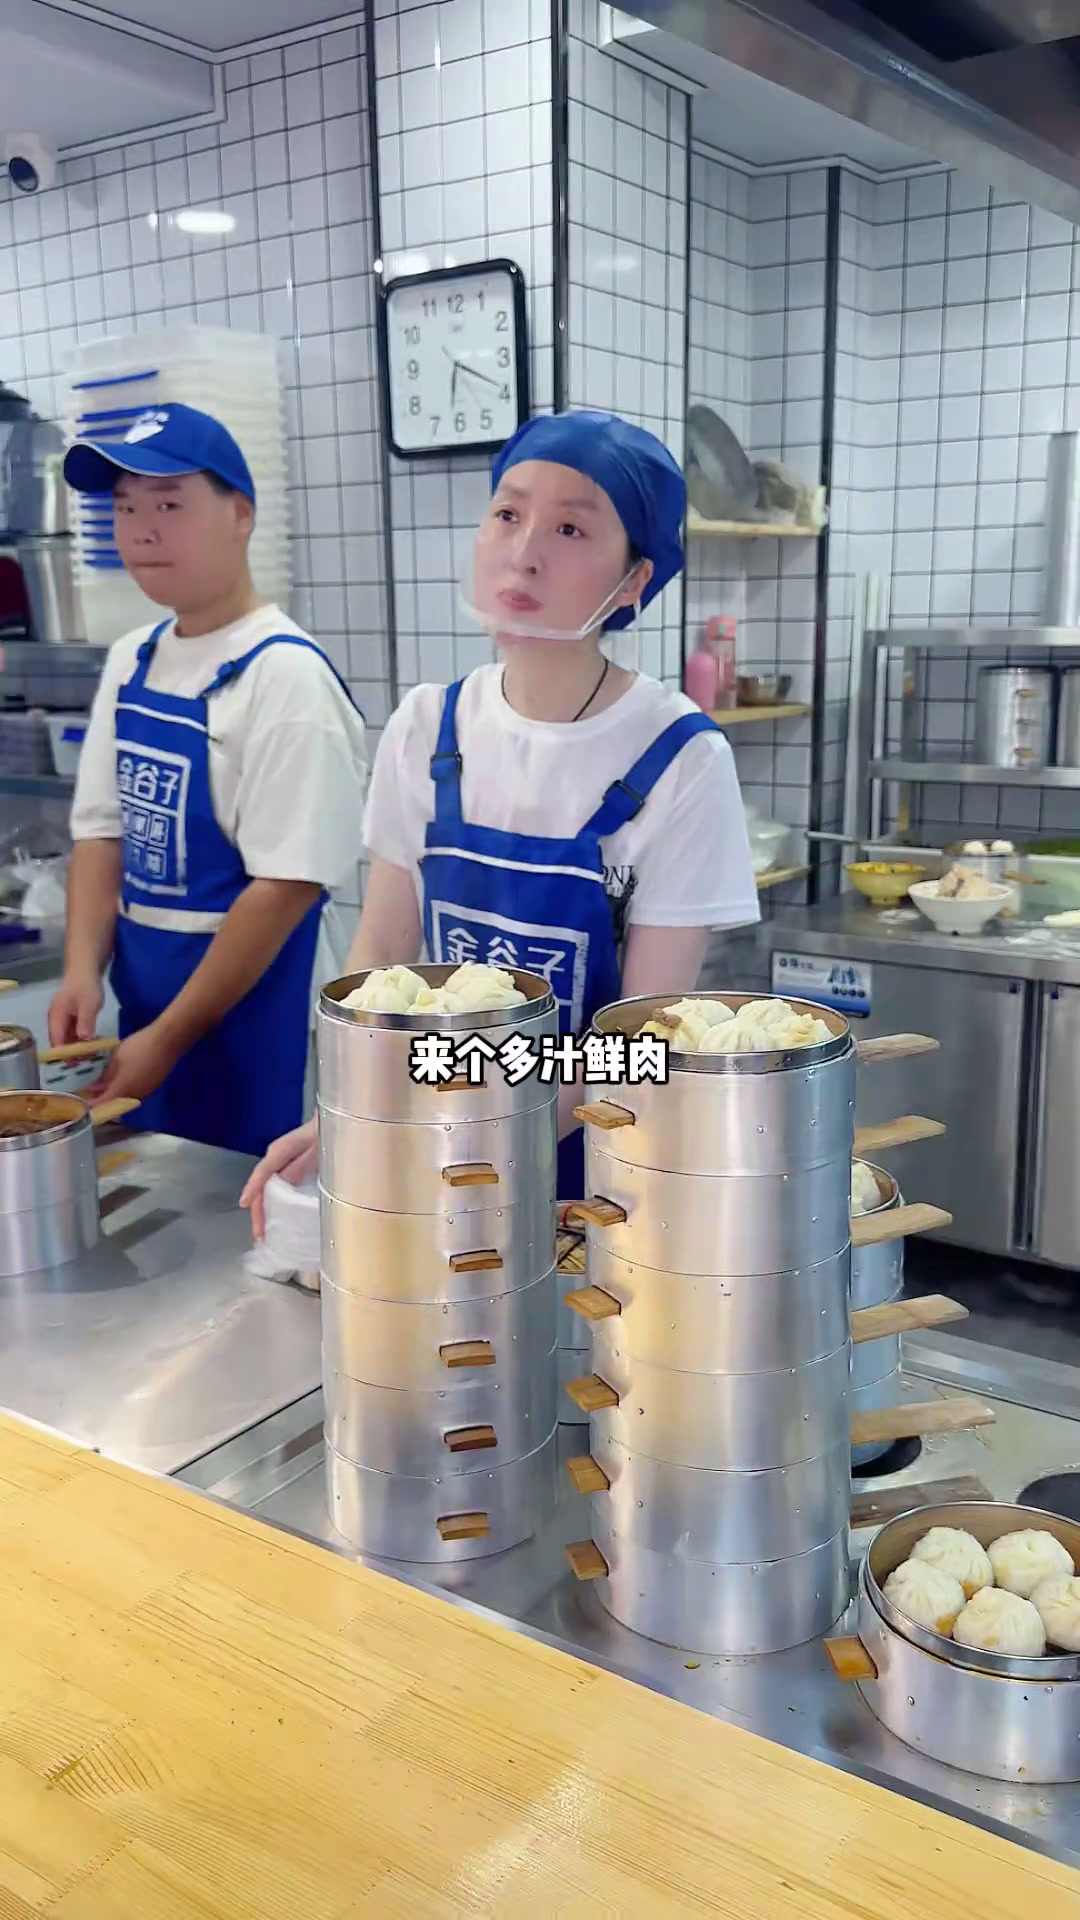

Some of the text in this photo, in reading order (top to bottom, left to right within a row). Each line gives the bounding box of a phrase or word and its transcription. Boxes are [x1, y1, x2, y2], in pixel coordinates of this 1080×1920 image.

[422, 300, 438, 318] 11
[448, 294, 464, 313] 12
[478, 291, 485, 311] 1
[495, 311, 509, 332] 2
[404, 325, 421, 345] 10
[498, 347, 511, 369] 3
[407, 359, 419, 380] 9
[500, 384, 511, 404] 4
[409, 396, 422, 416] 8
[430, 415, 441, 436] 7
[455, 412, 467, 433] 6
[480, 409, 493, 430] 5
[118, 757, 180, 805] 金谷子
